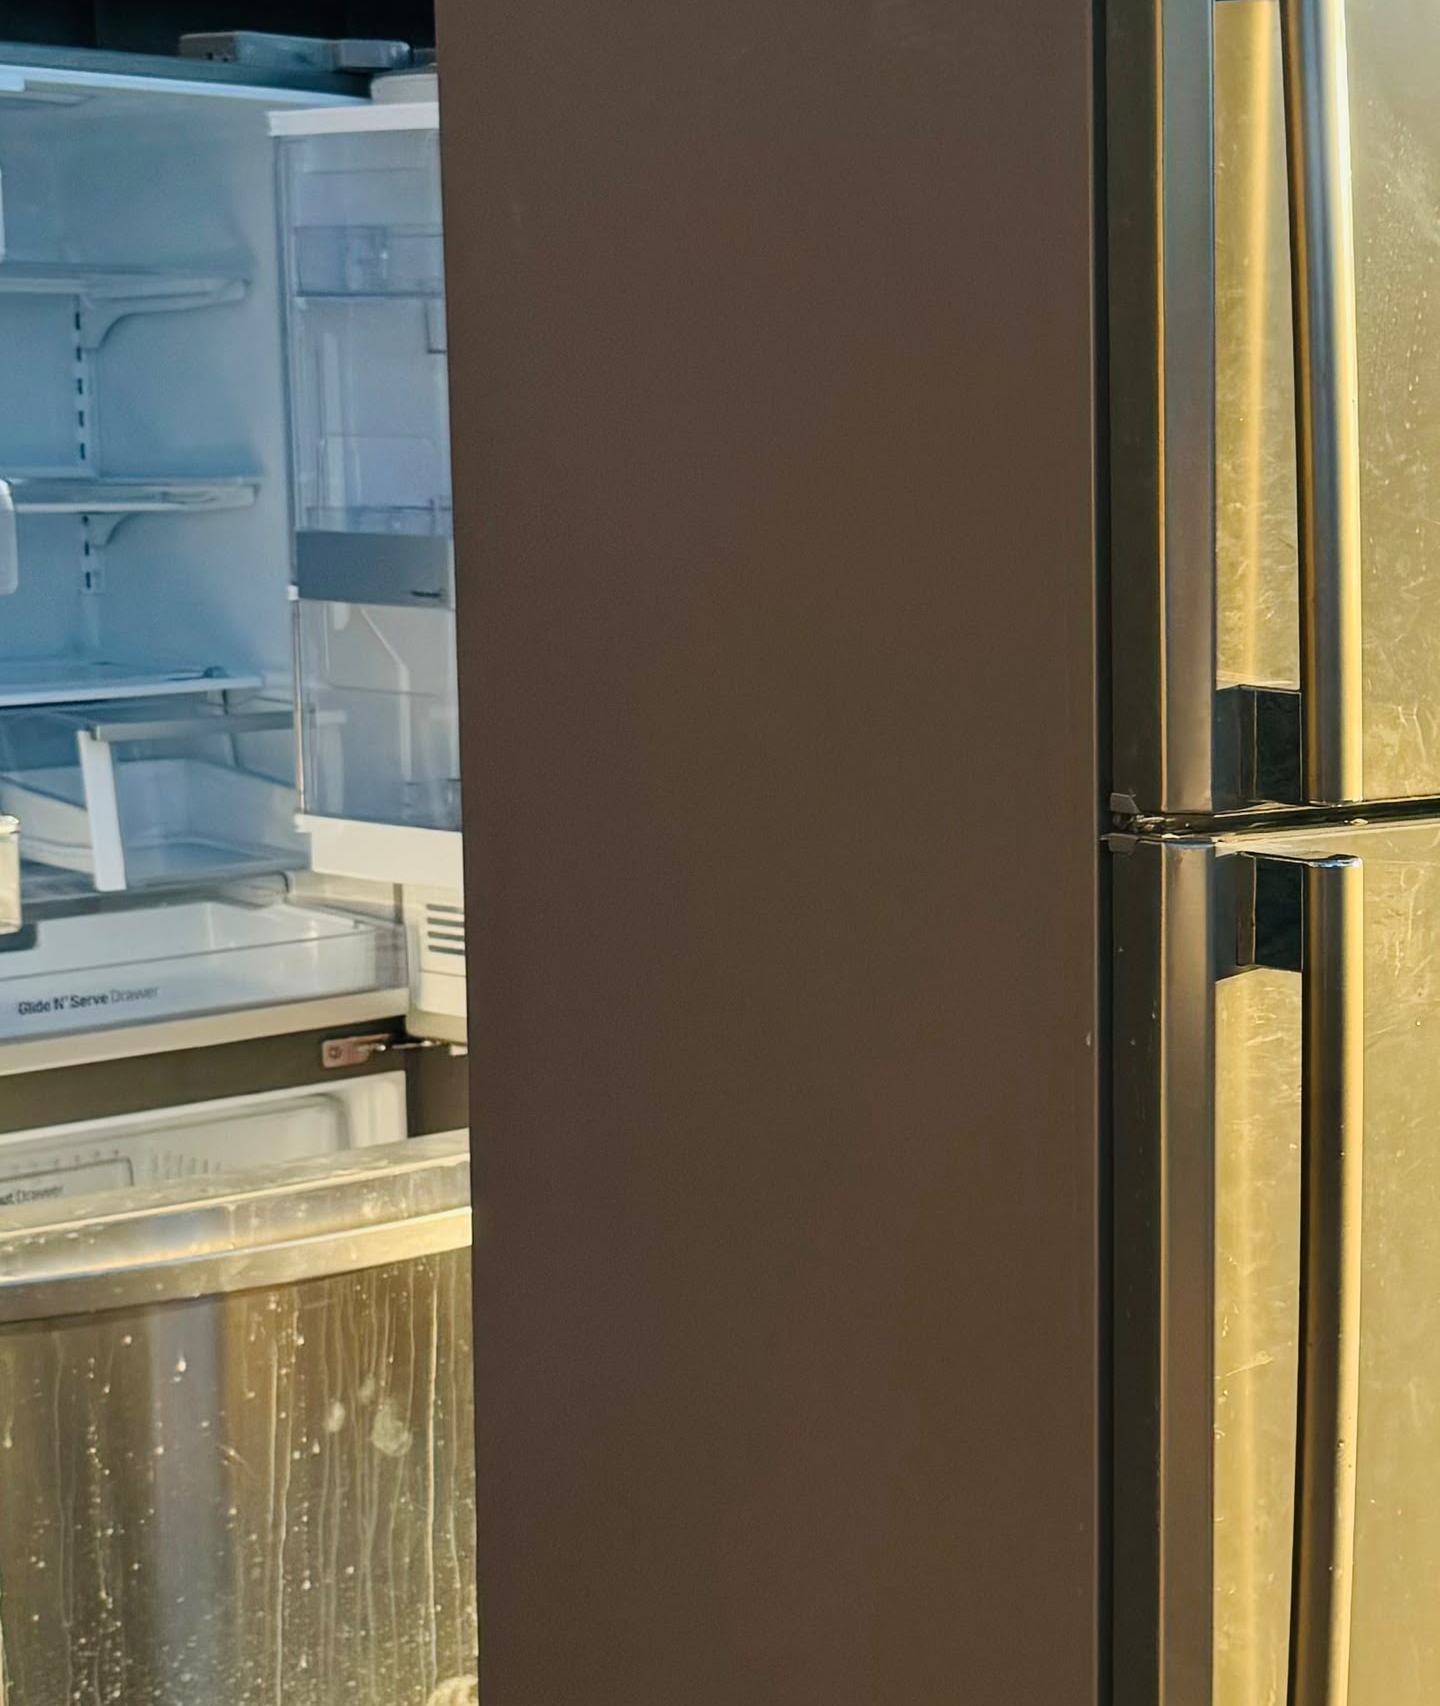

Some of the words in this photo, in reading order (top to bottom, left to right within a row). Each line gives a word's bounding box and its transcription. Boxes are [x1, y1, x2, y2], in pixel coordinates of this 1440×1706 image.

[18, 1001, 51, 1015] Glide
[70, 994, 109, 1009] Serve
[110, 987, 159, 1004] Drawer
